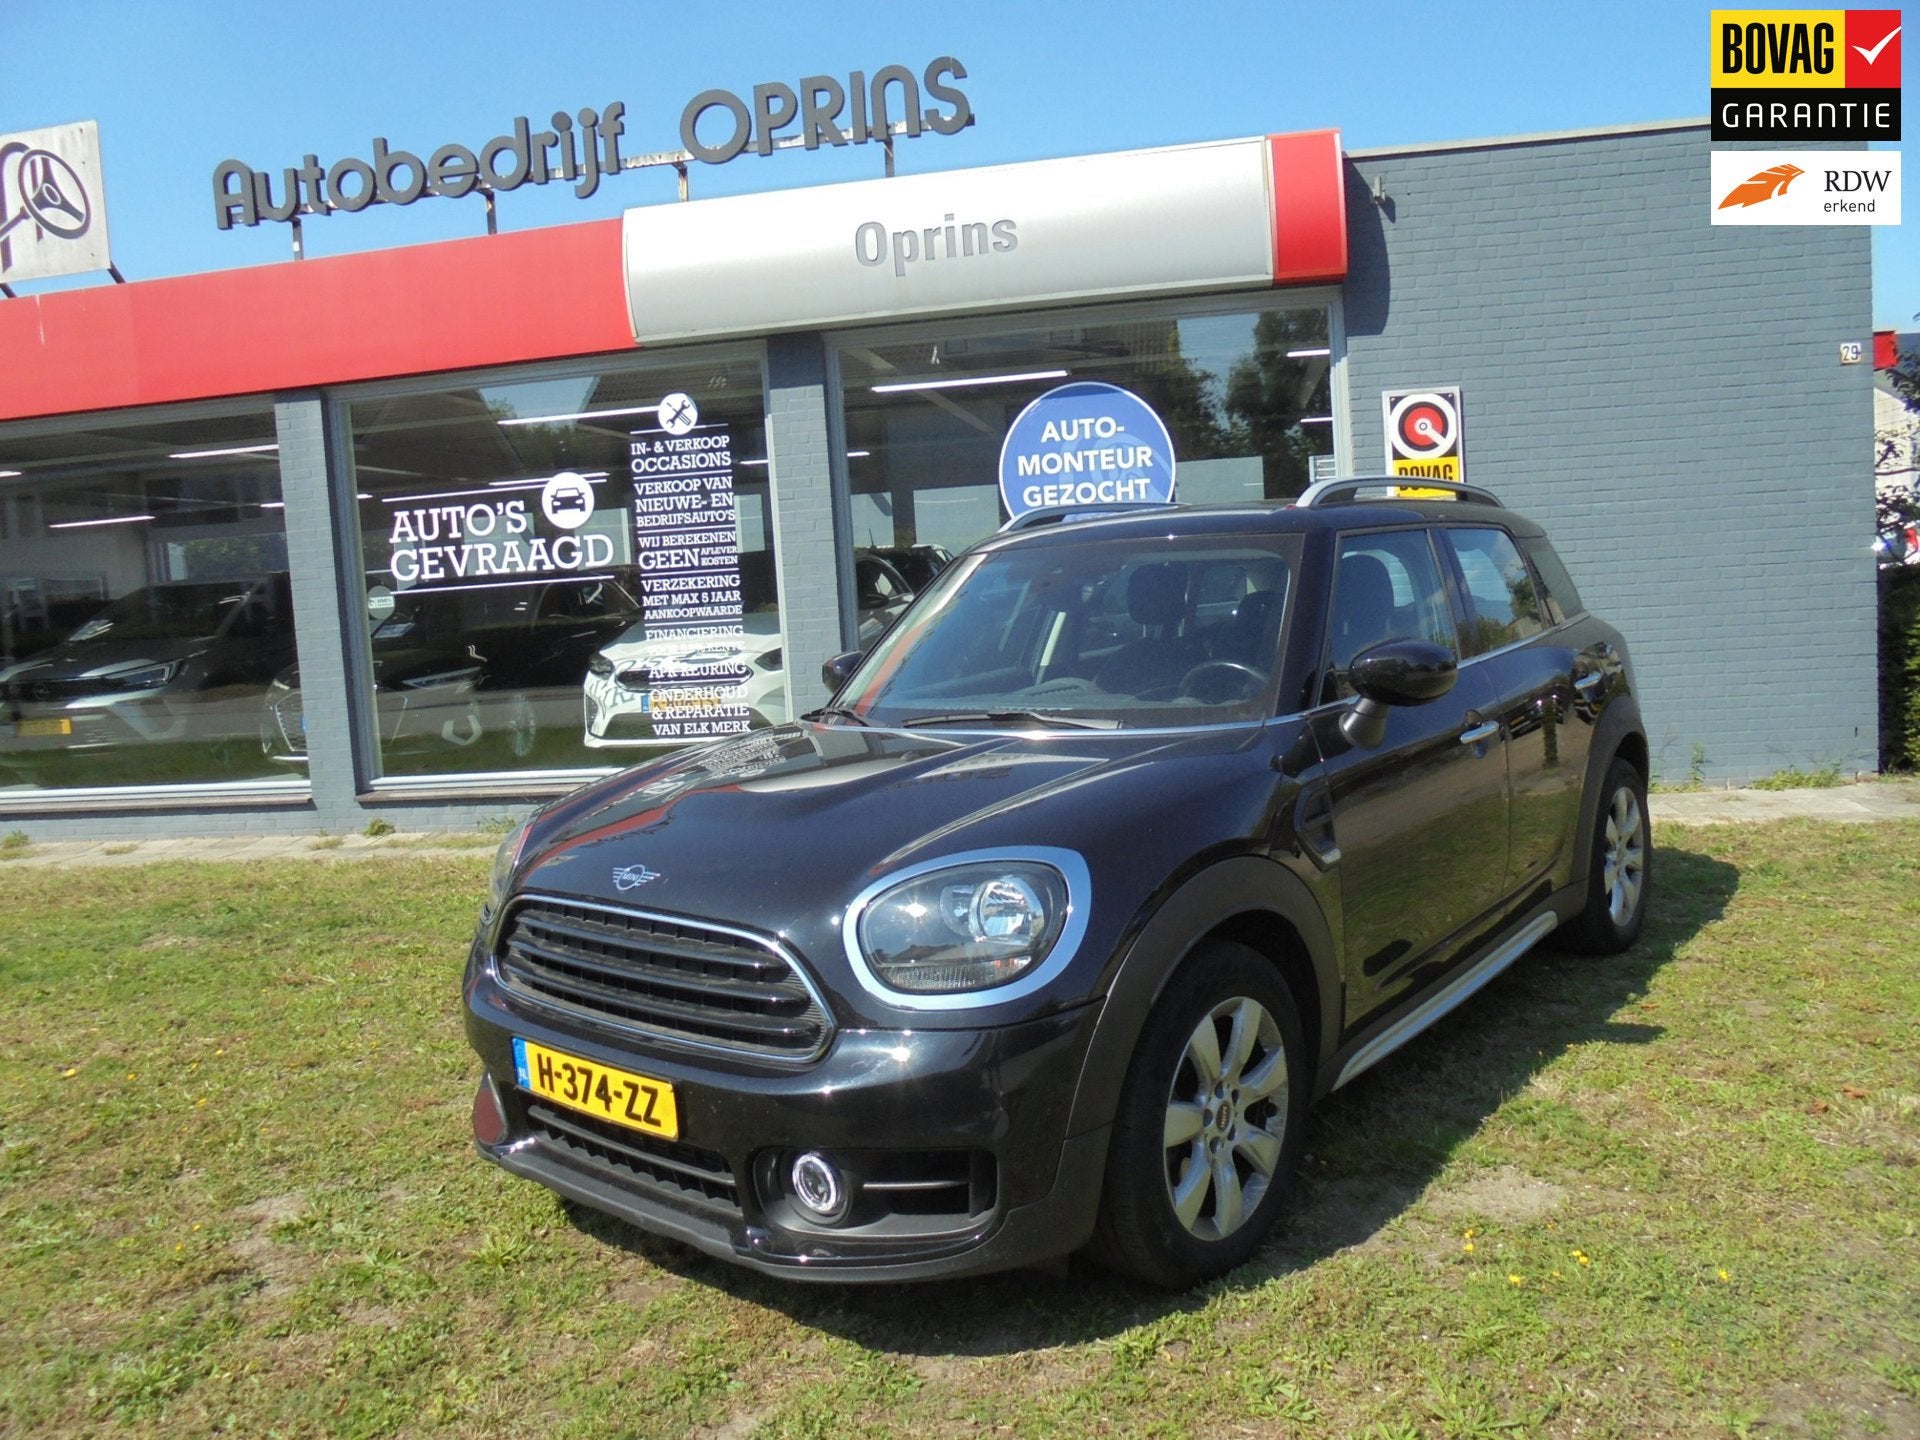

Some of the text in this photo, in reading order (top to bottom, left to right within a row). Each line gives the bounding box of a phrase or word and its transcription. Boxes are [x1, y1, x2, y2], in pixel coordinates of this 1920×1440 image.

[212, 56, 972, 230] Autobedrijf OPRINS
[855, 213, 1019, 277] Oprins
[1842, 345, 1860, 361] 29
[1041, 416, 1125, 443] AUTO-
[631, 435, 730, 455] IN- & VERKOOP
[631, 451, 732, 473] OCCASIONS
[1017, 446, 1153, 476] MONTEUR
[634, 476, 733, 496] VERKOOP VAN
[1023, 478, 1151, 507] GEZOCHT
[635, 492, 734, 513] NIEUWE- EN
[389, 500, 528, 543] AUTO'S
[636, 510, 736, 527] BEDRIJFSAUTO'S
[638, 531, 736, 548] WIJ BEREKENEN
[390, 534, 614, 581] GEVRAAGD
[639, 548, 700, 570] GEEN
[701, 546, 737, 555] AFLEVER
[701, 555, 738, 566] KOSTEN
[641, 574, 741, 592] VERZEKERING
[642, 594, 669, 607] MET
[671, 592, 700, 604] MAX
[711, 590, 741, 602] JAAR
[644, 604, 743, 620] AANKOOPWAARDE
[646, 625, 743, 640] FINANCIERING
[650, 685, 748, 702] ONDERHOUD
[652, 708, 663, 720] &
[665, 703, 750, 719] REPARATIE
[652, 720, 751, 735] VAN ELK MERK
[537, 1053, 662, 1127] H-374-ZZ
